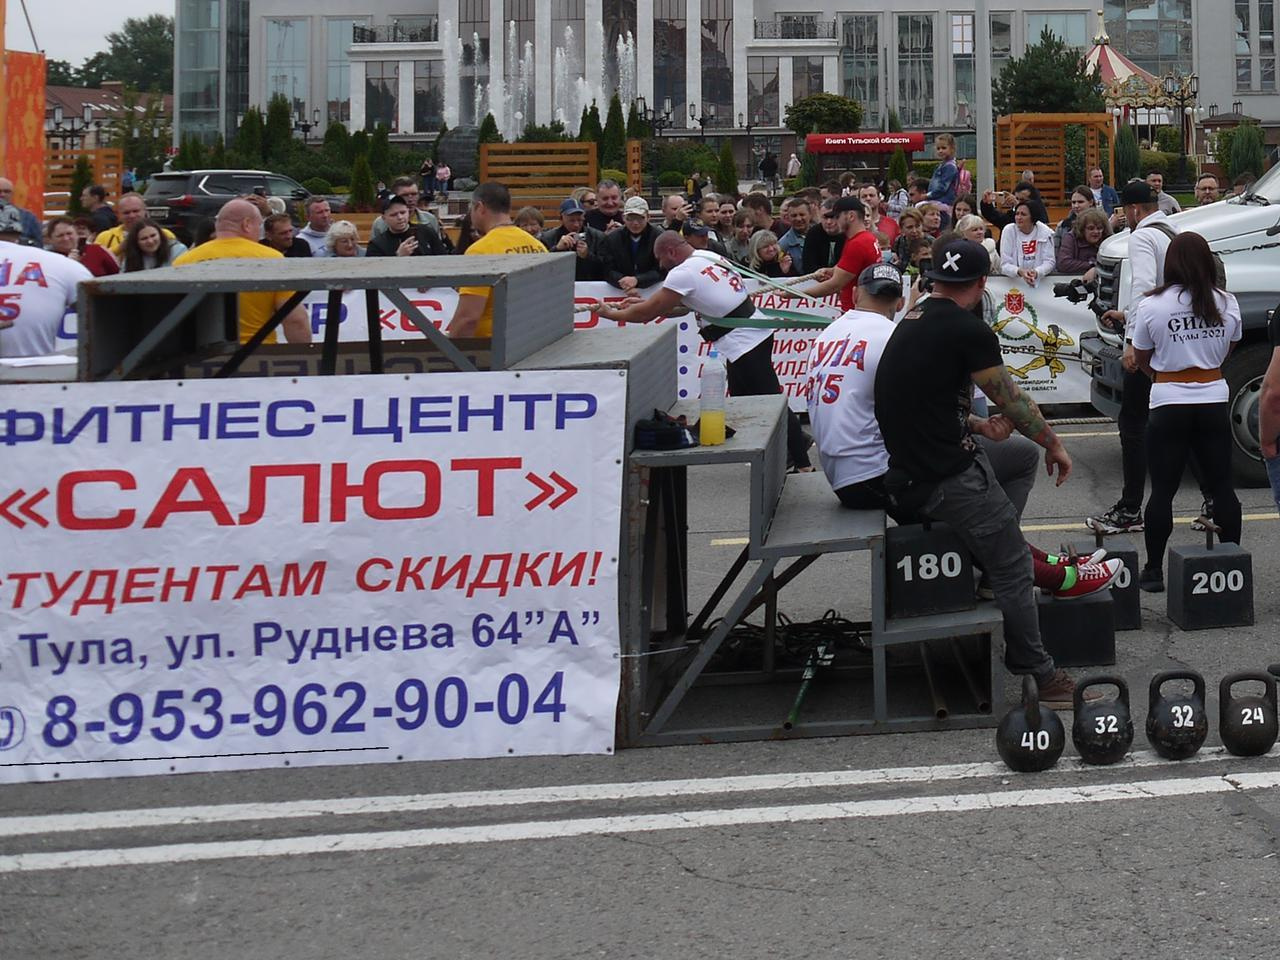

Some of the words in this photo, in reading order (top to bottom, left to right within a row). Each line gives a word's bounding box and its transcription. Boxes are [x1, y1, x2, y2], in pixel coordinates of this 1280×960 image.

[1202, 329, 1225, 339] 2021
[809, 338, 867, 372] УЛА
[0, 393, 598, 446] ФИТНЕС-ЦЕНТР
[0, 456, 579, 531] «САЛЮТ»
[896, 551, 962, 582] 180
[0, 561, 327, 616] ТУДЕНТАМ
[355, 551, 603, 598] СКИДКИ!
[1191, 569, 1244, 596] 200
[18, 632, 148, 675] Тула,
[164, 633, 235, 671] ул.
[253, 620, 454, 665] Руднева
[42, 671, 567, 748] 8-953-962-90-04
[1170, 705, 1195, 729] 32
[1241, 707, 1265, 726] 24
[1020, 730, 1050, 752] 40
[1095, 716, 1119, 735] 32
